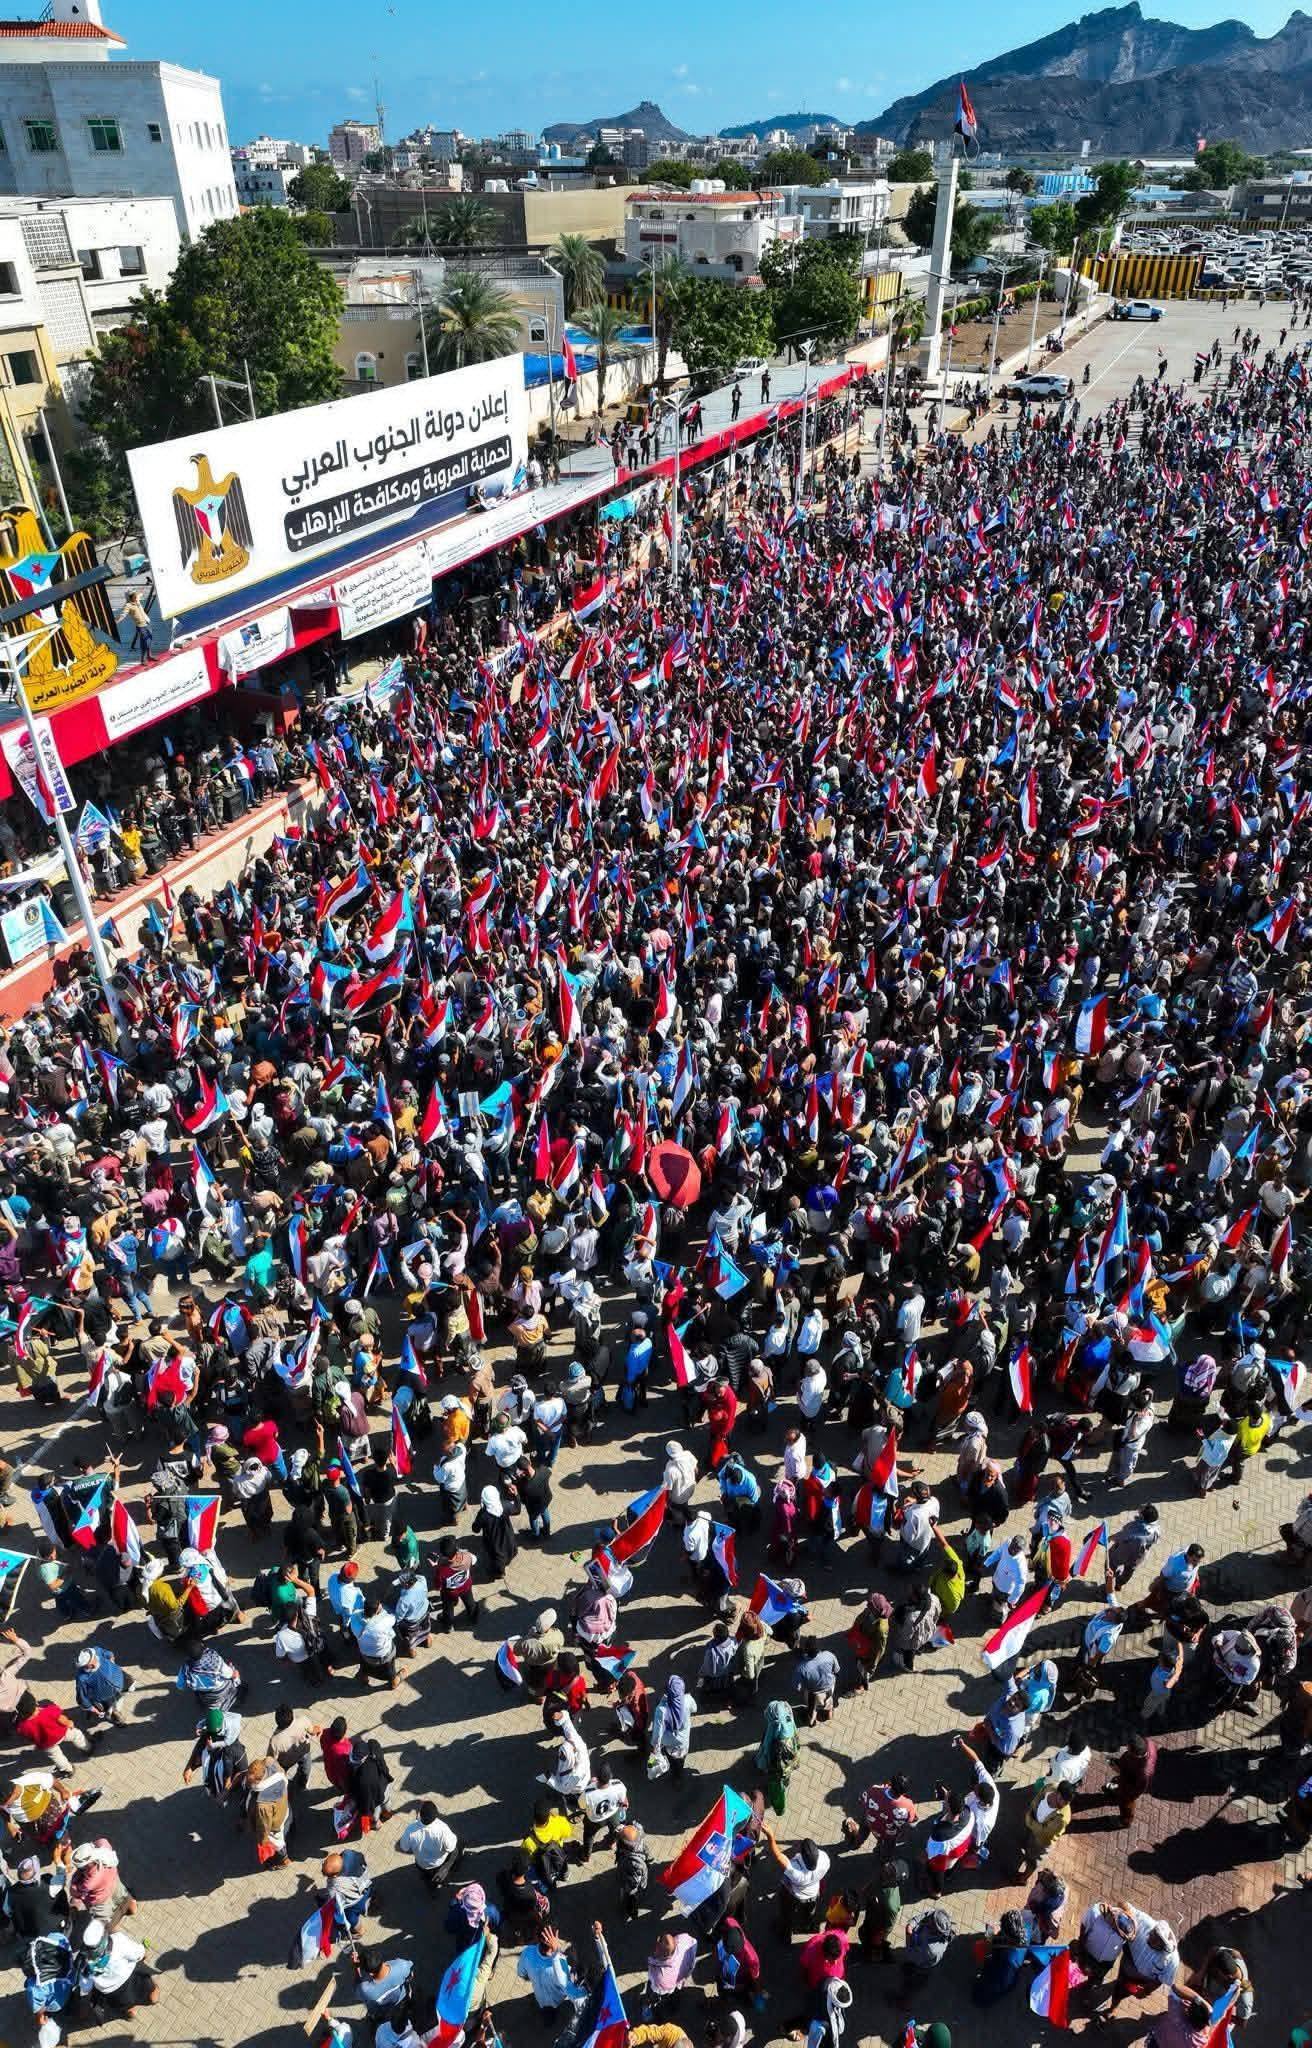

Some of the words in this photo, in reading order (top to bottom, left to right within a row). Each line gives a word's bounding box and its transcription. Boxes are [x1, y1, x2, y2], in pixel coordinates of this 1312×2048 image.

[424, 410, 465, 441] دولة
[468, 389, 509, 432] إعلان
[353, 417, 421, 471] الجنوب
[471, 439, 511, 476] لحماية
[281, 439, 349, 505] العربي
[423, 458, 469, 493] العروبة
[353, 477, 421, 517] ومكافحة
[288, 499, 350, 546] الإرهاب
[61, 673, 89, 695] الجنوب
[87, 663, 107, 678] دولة
[33, 686, 60, 704] العربي
